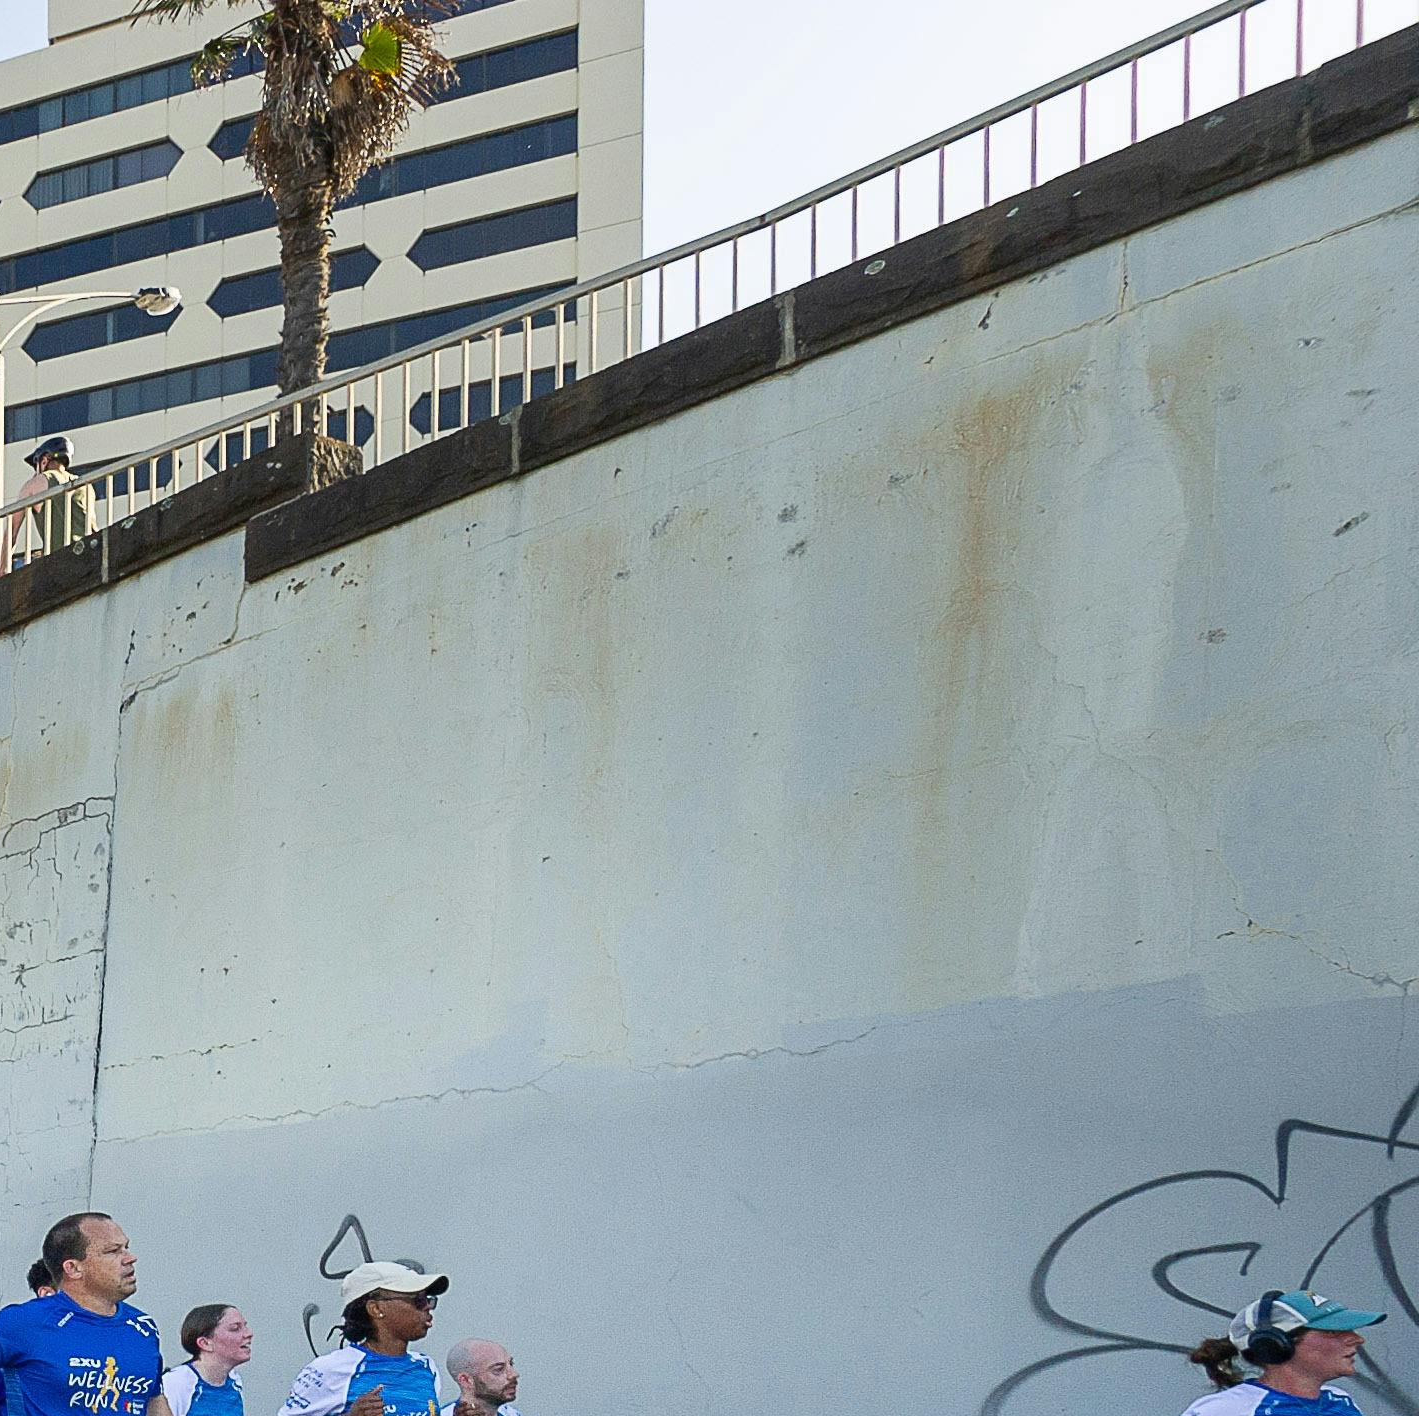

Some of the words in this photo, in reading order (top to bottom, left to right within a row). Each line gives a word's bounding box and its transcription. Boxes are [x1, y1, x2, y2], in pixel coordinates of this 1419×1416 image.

[69, 1358, 101, 1368] 2XU
[68, 1371, 153, 1394] WELLNESS
[69, 1391, 108, 1409] RUN
